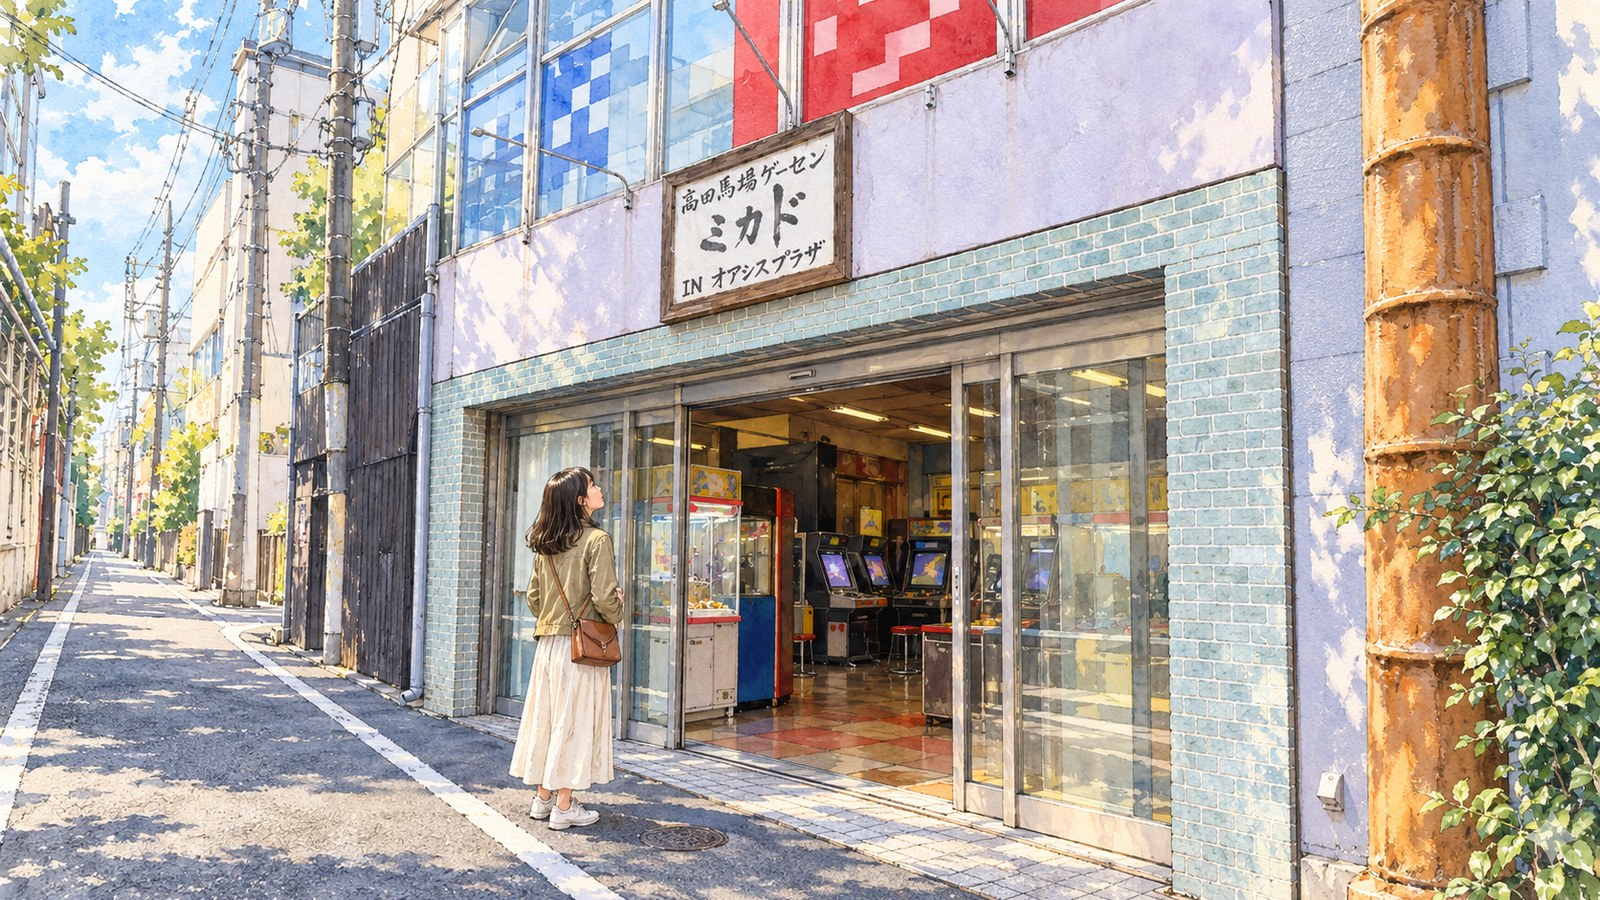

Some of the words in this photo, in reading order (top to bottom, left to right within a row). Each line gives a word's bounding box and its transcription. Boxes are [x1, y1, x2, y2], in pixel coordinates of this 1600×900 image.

[681, 144, 828, 215] 高田馬場ゲーセン
[700, 183, 806, 253] ミカド
[682, 276, 703, 297] IN
[711, 239, 826, 289] オアシスプラザ
